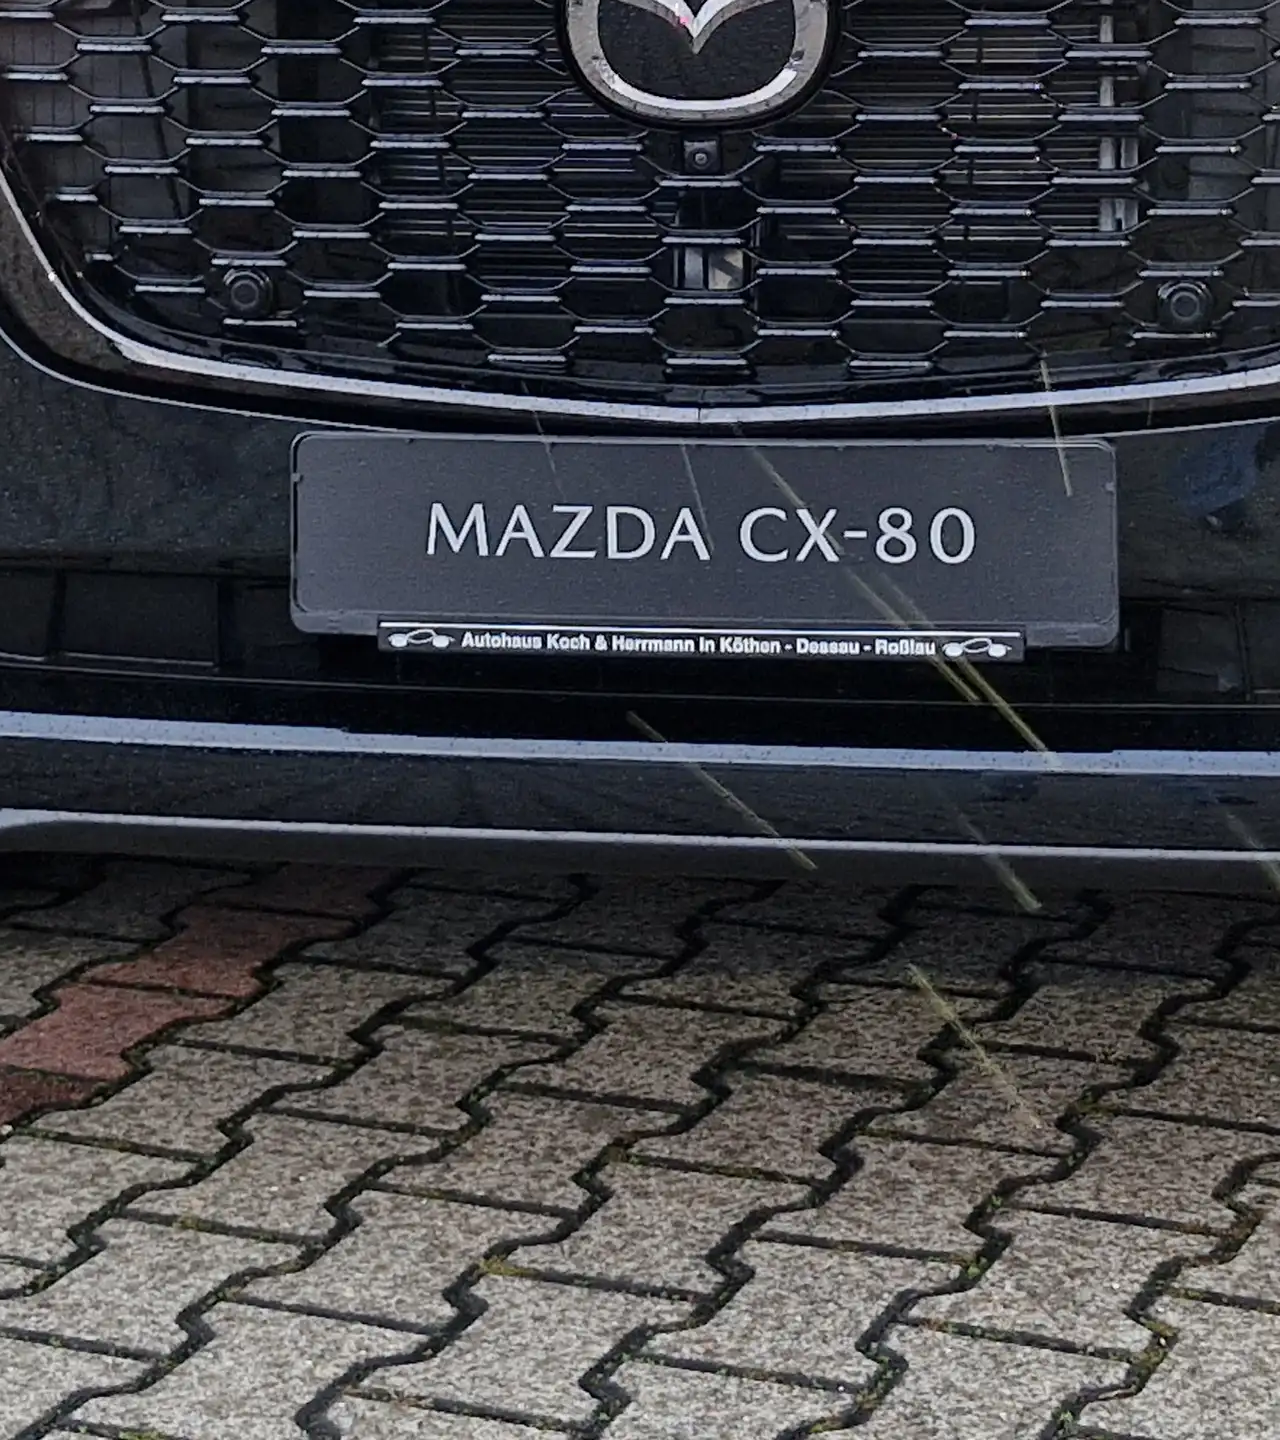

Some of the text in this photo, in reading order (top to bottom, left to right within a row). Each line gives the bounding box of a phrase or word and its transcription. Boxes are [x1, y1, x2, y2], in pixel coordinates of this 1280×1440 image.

[426, 502, 976, 564] MAZDA CX-80
[461, 631, 542, 650] Autohaus
[546, 633, 590, 651] Koch
[594, 634, 608, 651] &
[612, 634, 695, 653] Herrmann
[720, 636, 781, 654] Köthen
[796, 638, 860, 655] Dessau
[875, 639, 936, 656] Roßlau
